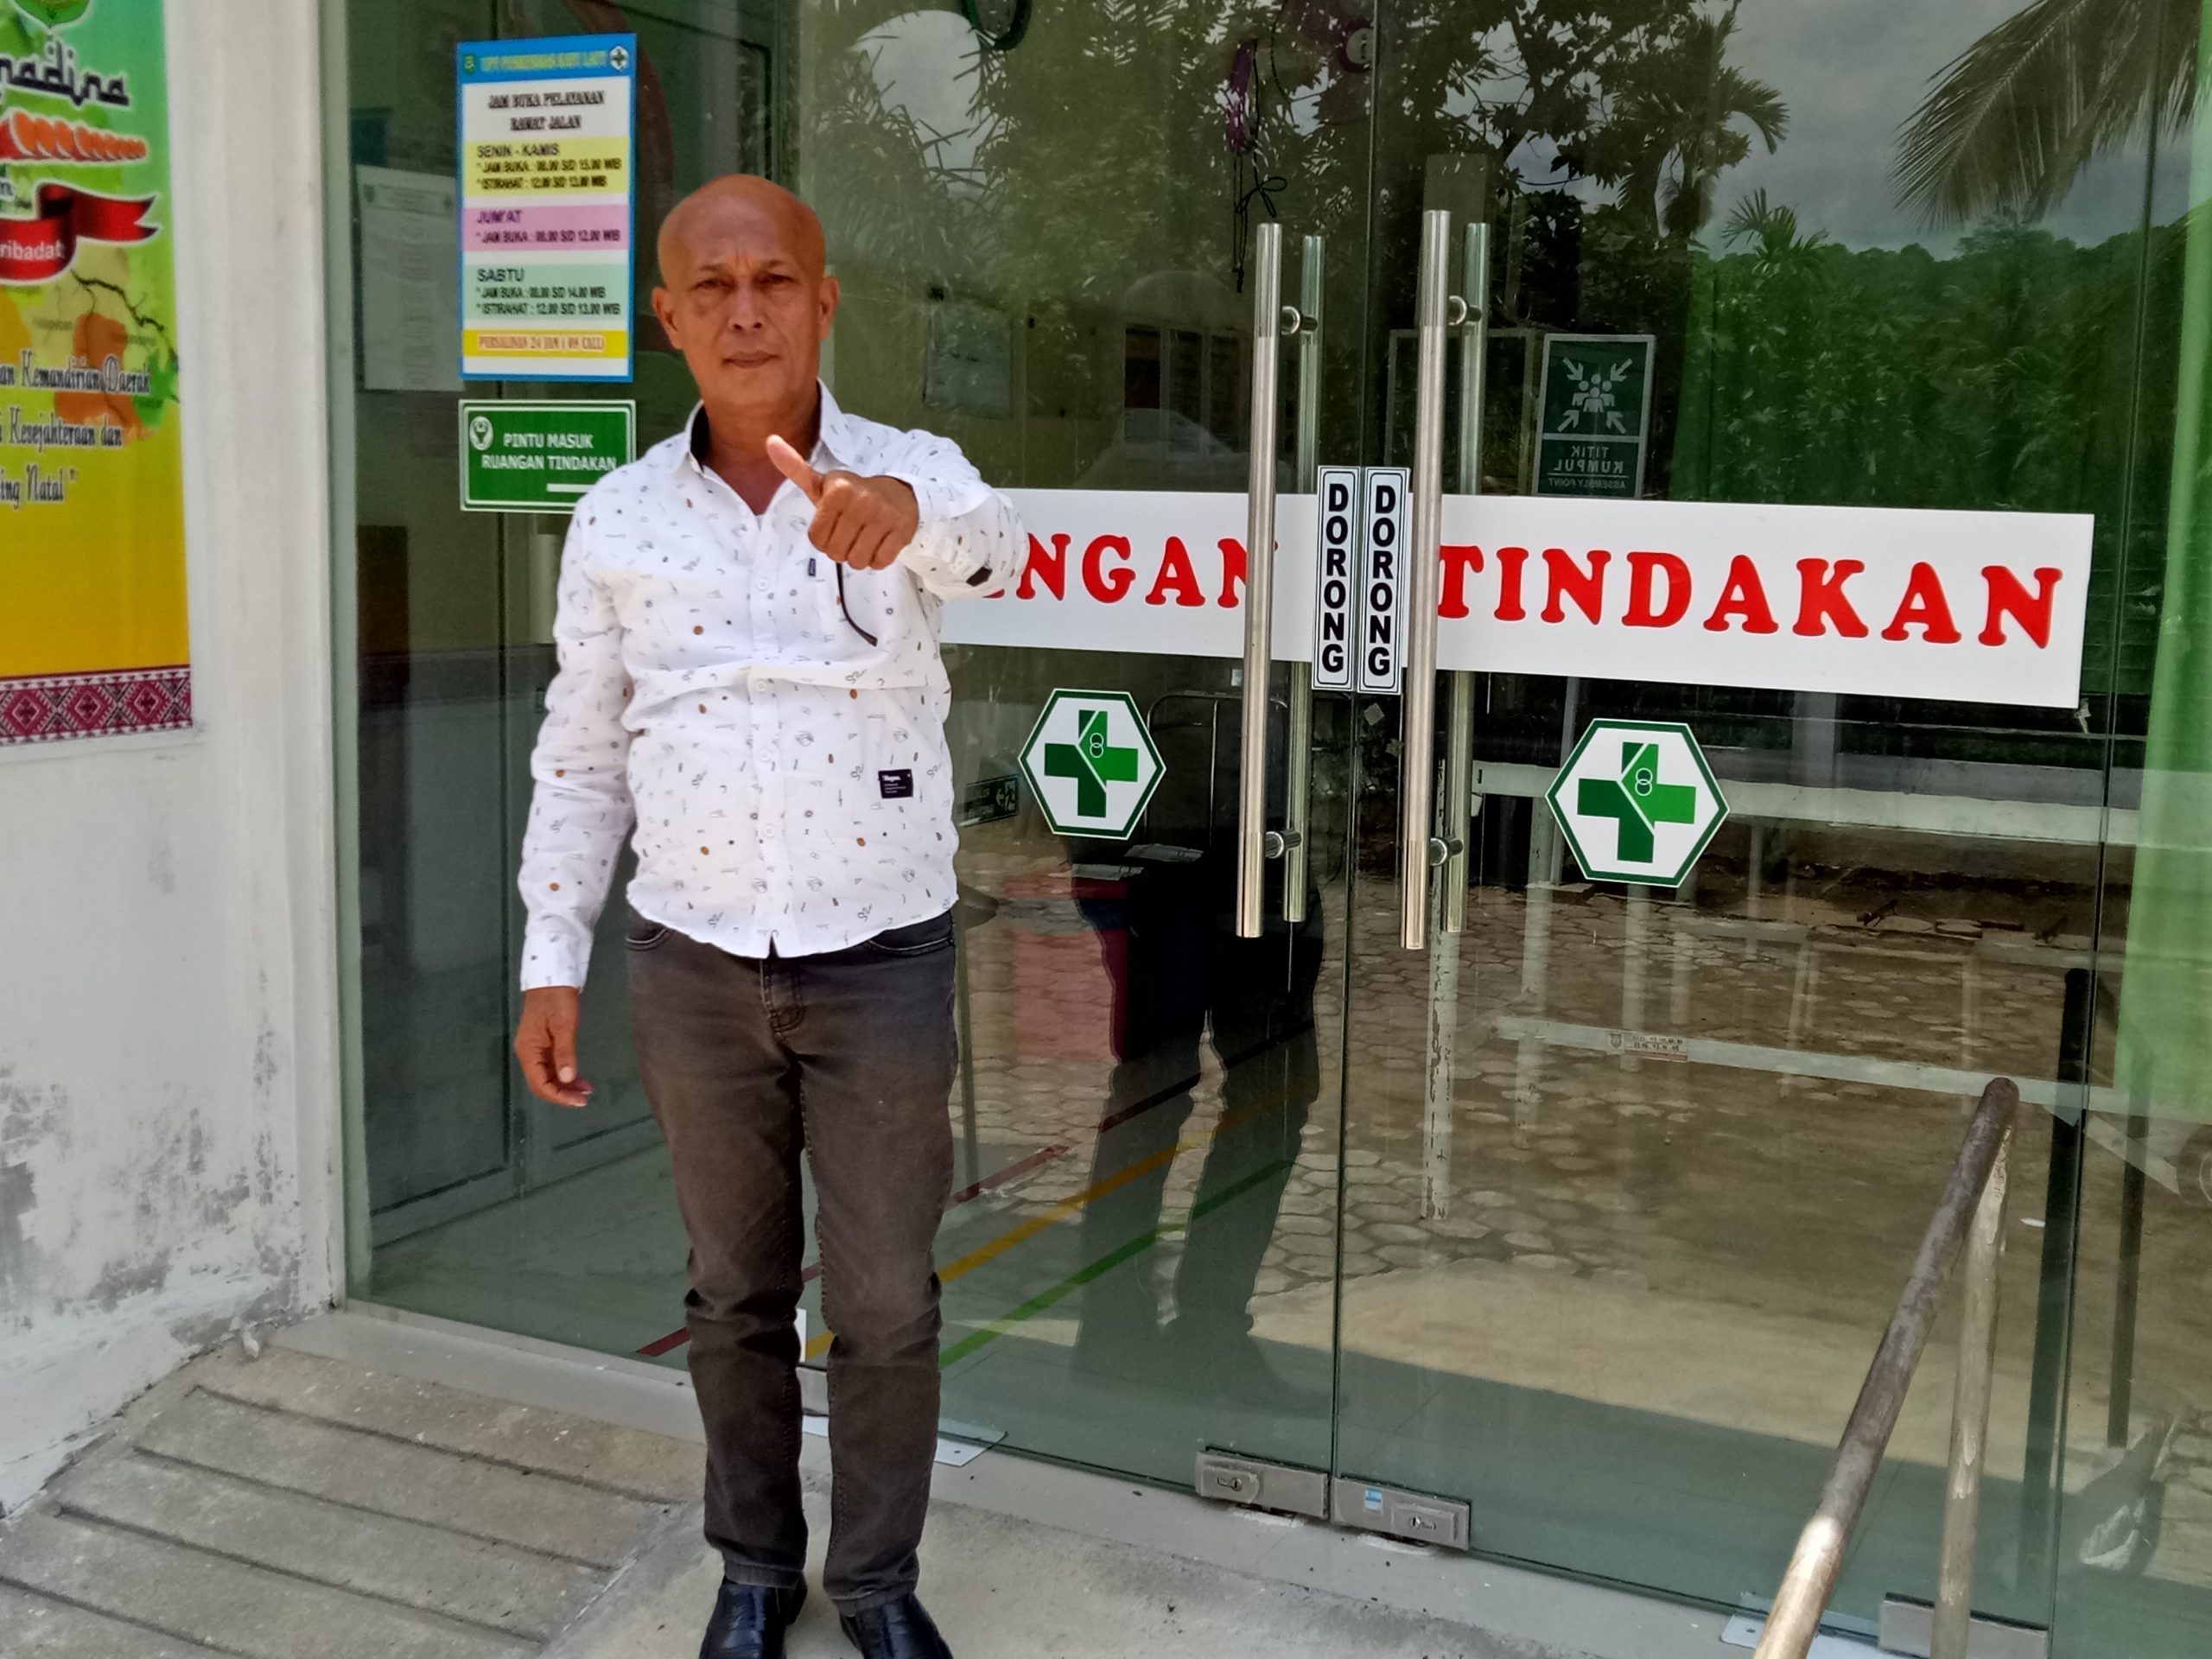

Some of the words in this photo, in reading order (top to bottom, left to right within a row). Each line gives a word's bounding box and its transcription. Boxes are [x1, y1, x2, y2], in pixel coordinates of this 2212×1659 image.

[477, 145, 512, 158] SENIN
[522, 143, 560, 156] KAMIS
[477, 268, 525, 283] SABTU
[503, 433, 544, 448] PINTU
[546, 434, 594, 449] MASUK
[481, 454, 544, 470] RUANGAN
[548, 455, 617, 471] TINDAKAN
[1321, 483, 1349, 673] DORONG
[1368, 485, 1396, 677] DORONG
[1438, 545, 2062, 648] TINDAKAN
